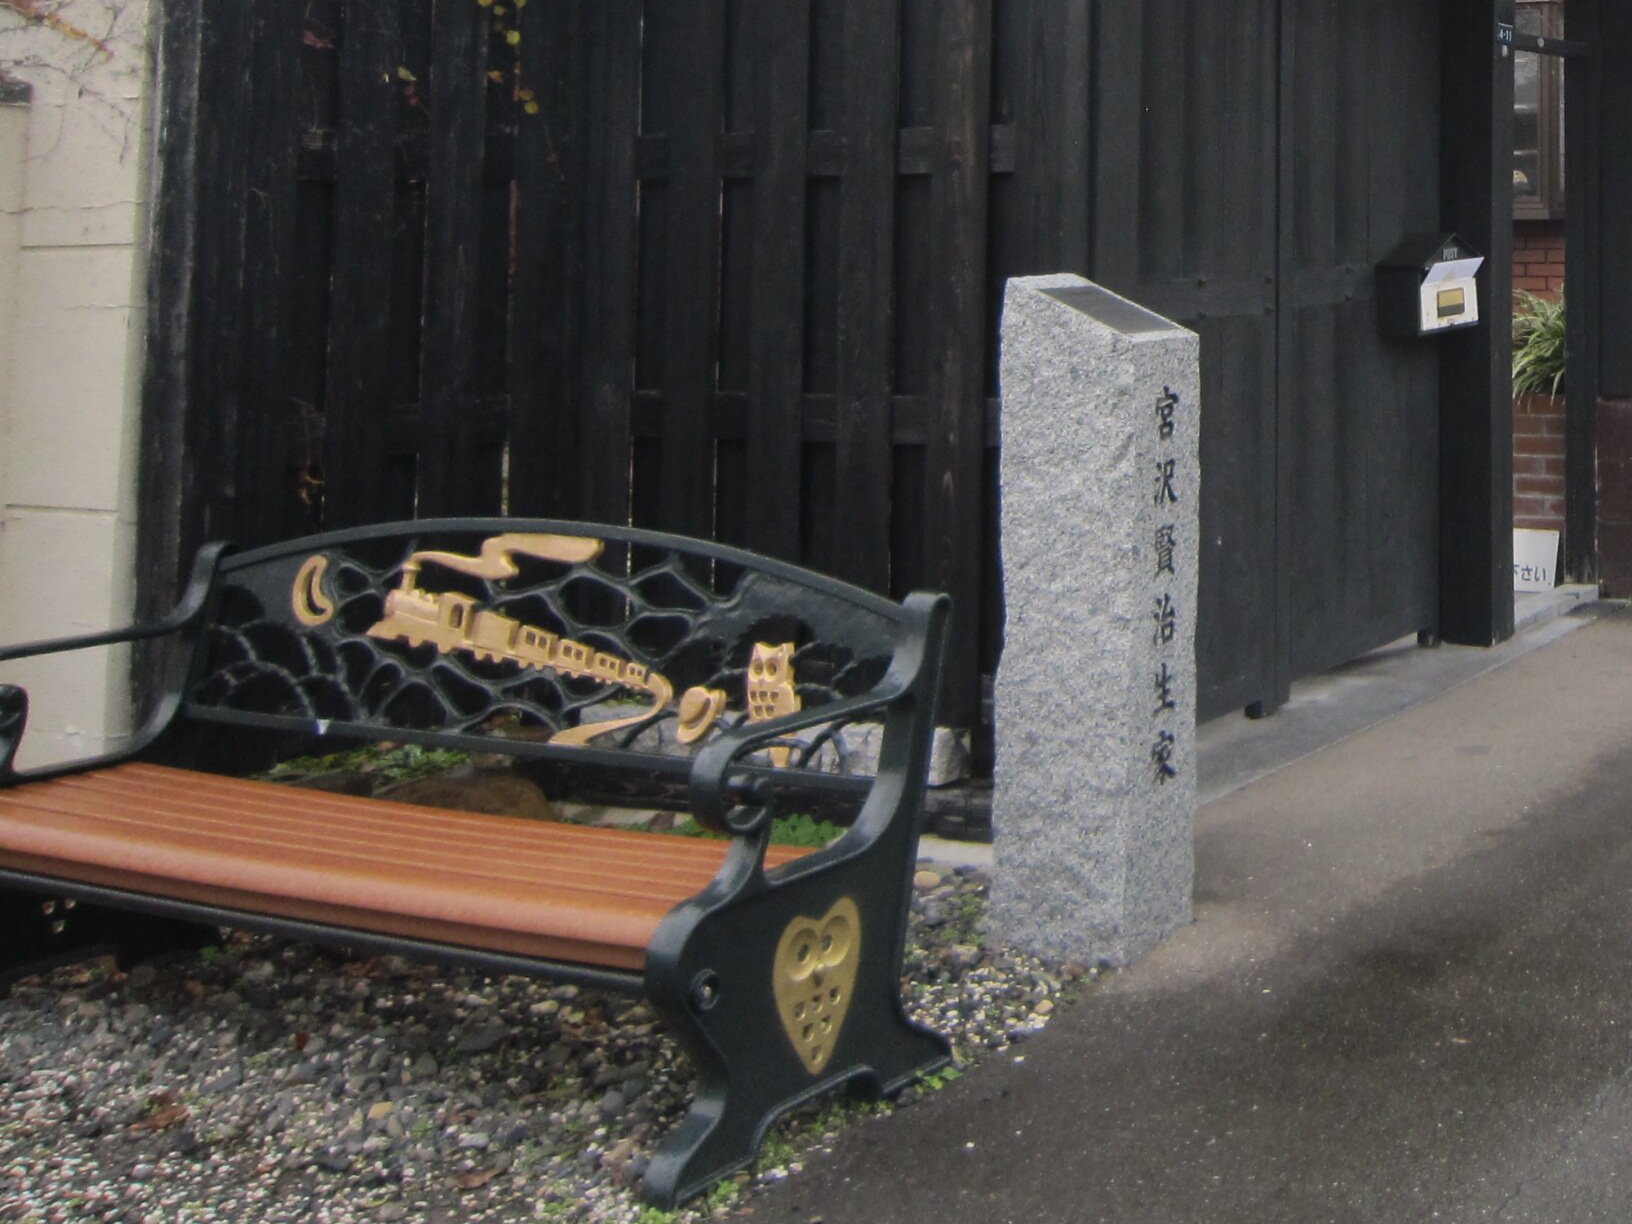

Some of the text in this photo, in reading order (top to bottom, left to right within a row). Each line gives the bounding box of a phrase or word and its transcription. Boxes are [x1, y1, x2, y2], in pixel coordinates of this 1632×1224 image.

[1151, 385, 1179, 786] 宮沢賢治生家
